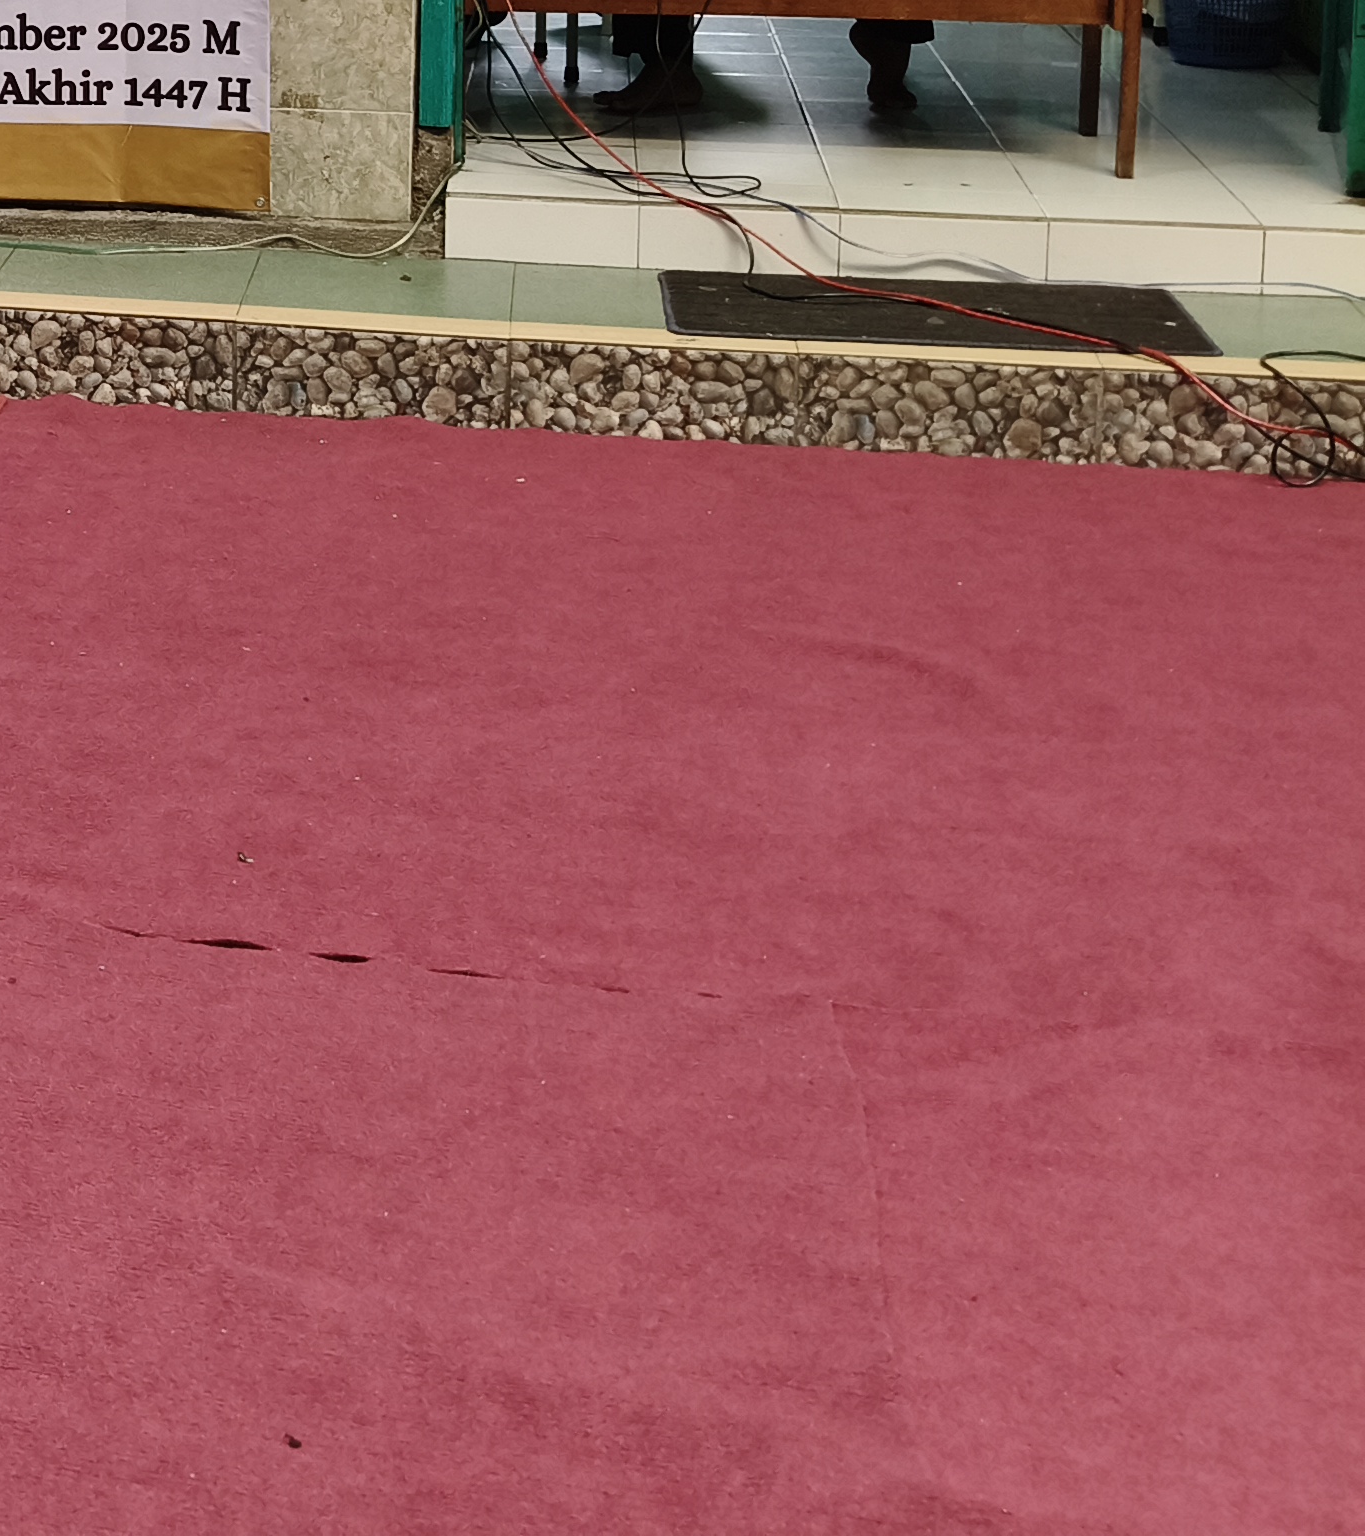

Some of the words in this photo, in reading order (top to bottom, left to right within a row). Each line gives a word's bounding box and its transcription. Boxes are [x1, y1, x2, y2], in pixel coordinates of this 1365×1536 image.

[97, 22, 190, 53] 2025
[202, 19, 241, 56] M
[123, 77, 208, 111] 1447
[216, 78, 251, 113] H
